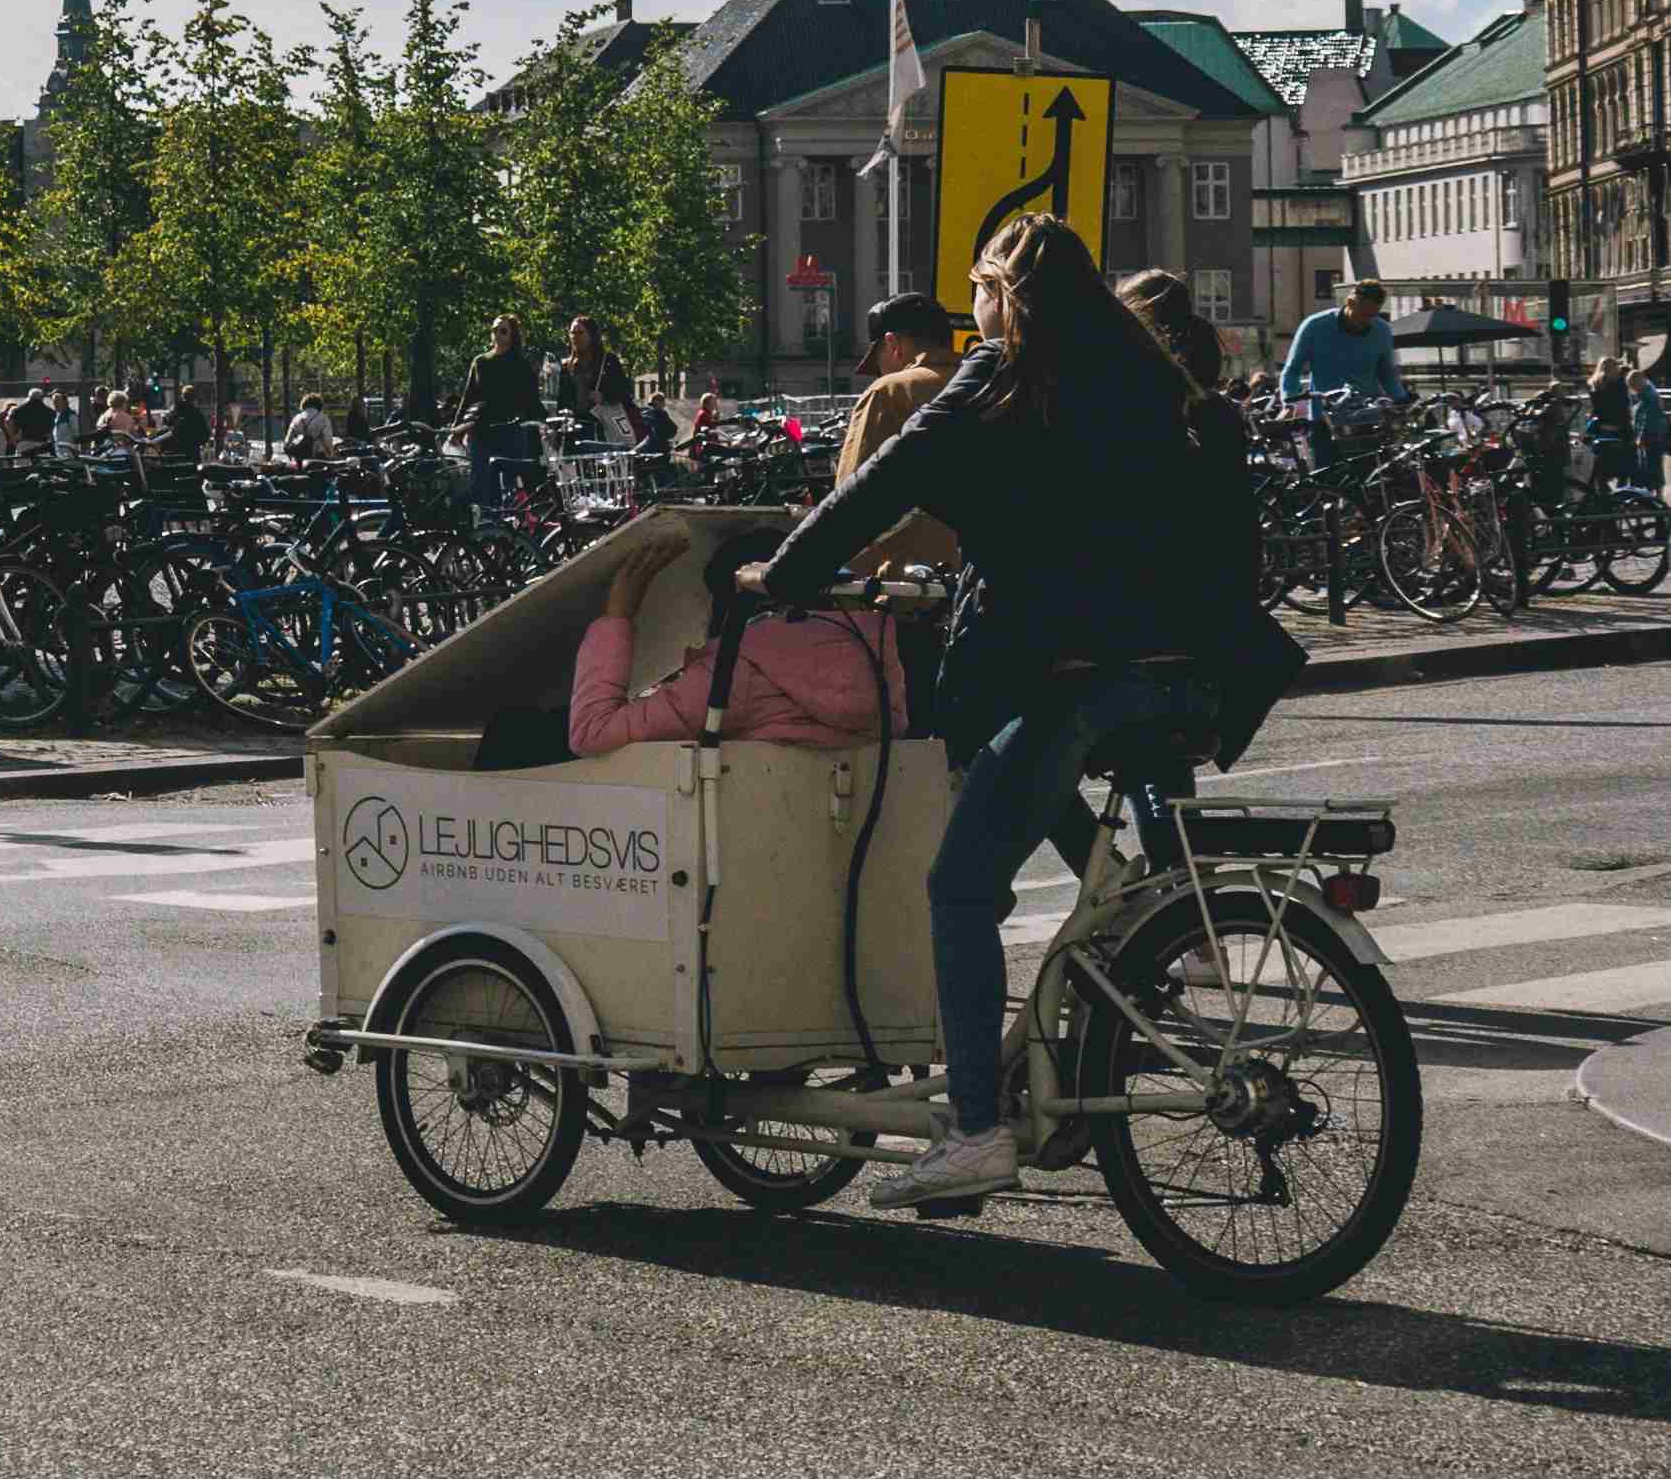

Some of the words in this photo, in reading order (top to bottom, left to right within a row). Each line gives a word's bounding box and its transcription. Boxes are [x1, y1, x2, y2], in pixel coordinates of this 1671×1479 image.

[419, 814, 660, 872] LEJLIGHEDSVIS
[420, 862, 478, 880] AIRBNB
[484, 866, 528, 884] UDEN
[535, 872, 563, 887] ALT
[572, 874, 659, 895] BESVÆRET
